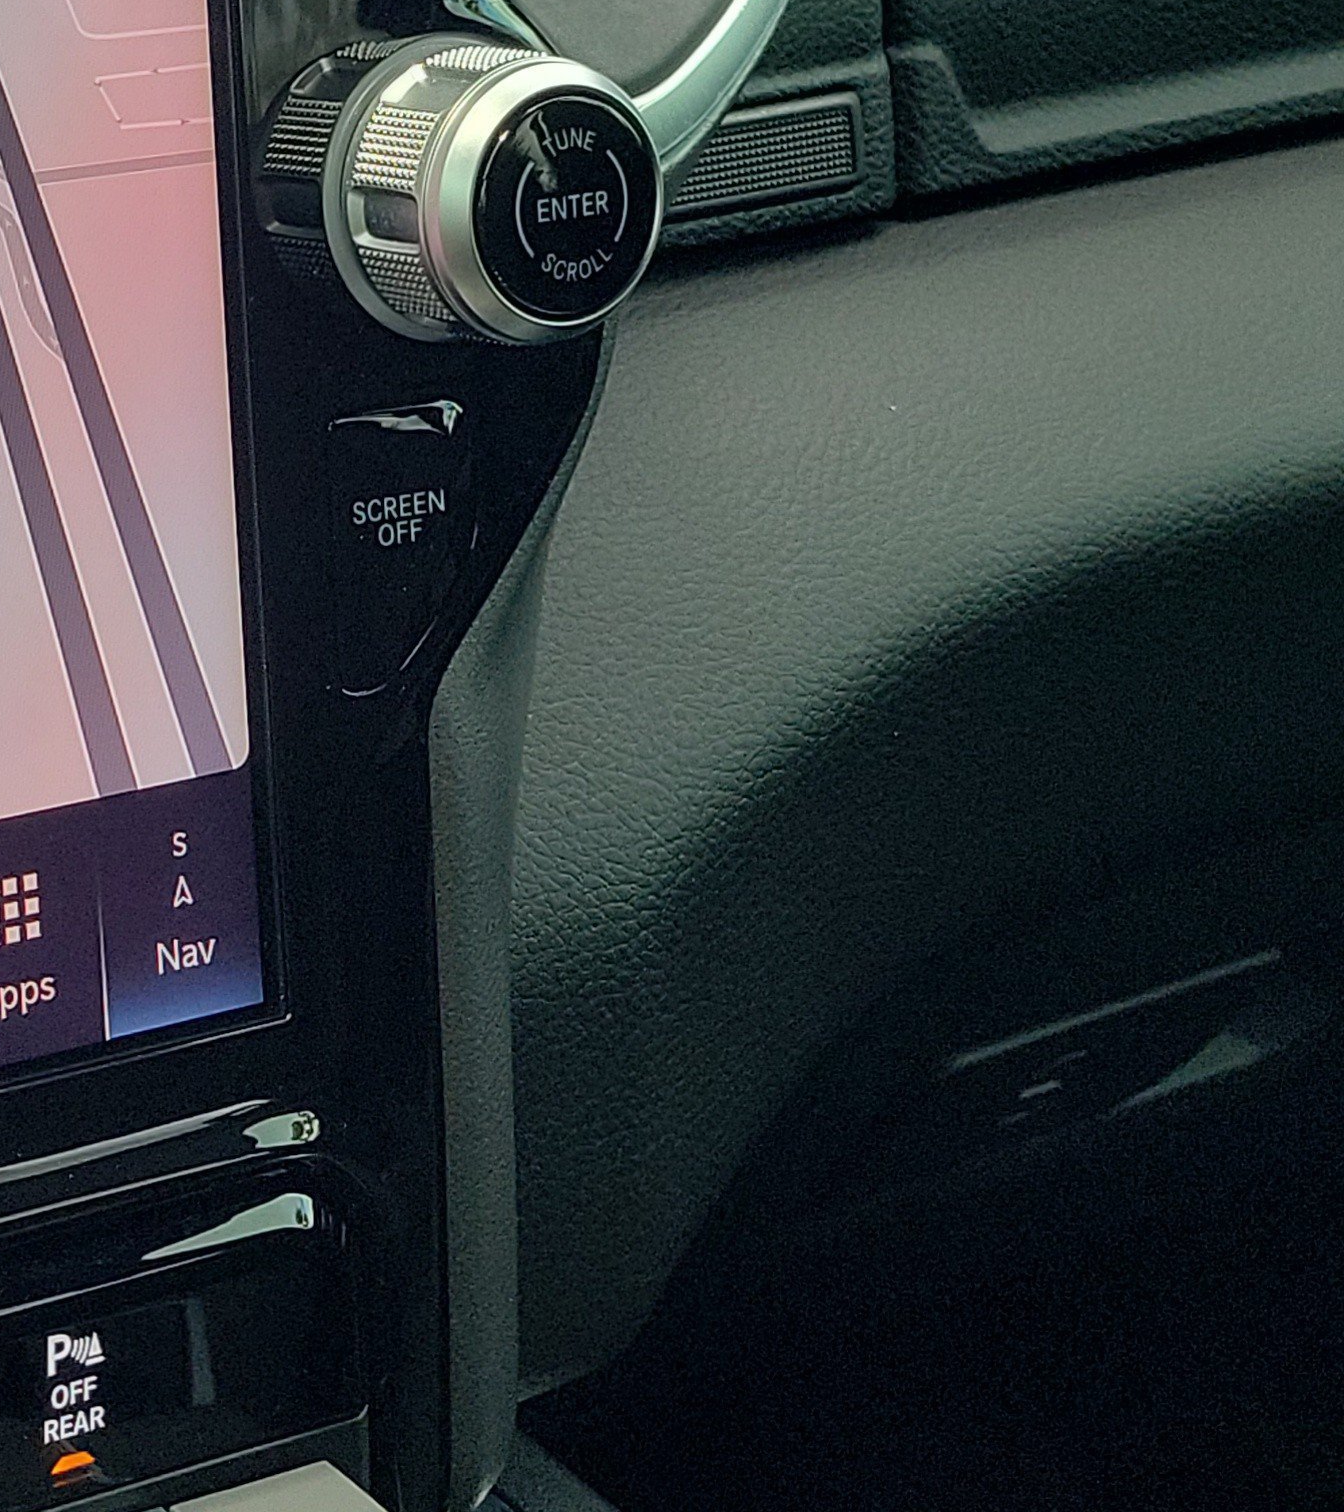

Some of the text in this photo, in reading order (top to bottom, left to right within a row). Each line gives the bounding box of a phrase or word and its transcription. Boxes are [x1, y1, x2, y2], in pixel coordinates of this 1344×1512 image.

[542, 127, 597, 157] TUNE
[537, 191, 609, 223] ENTER
[541, 248, 613, 282] SCROLL
[352, 490, 446, 526] SCREEN
[378, 520, 423, 547] OFF
[172, 832, 187, 858] S
[156, 937, 217, 975] Nav
[51, 1375, 98, 1409] OFF
[43, 1405, 106, 1445] REAR
